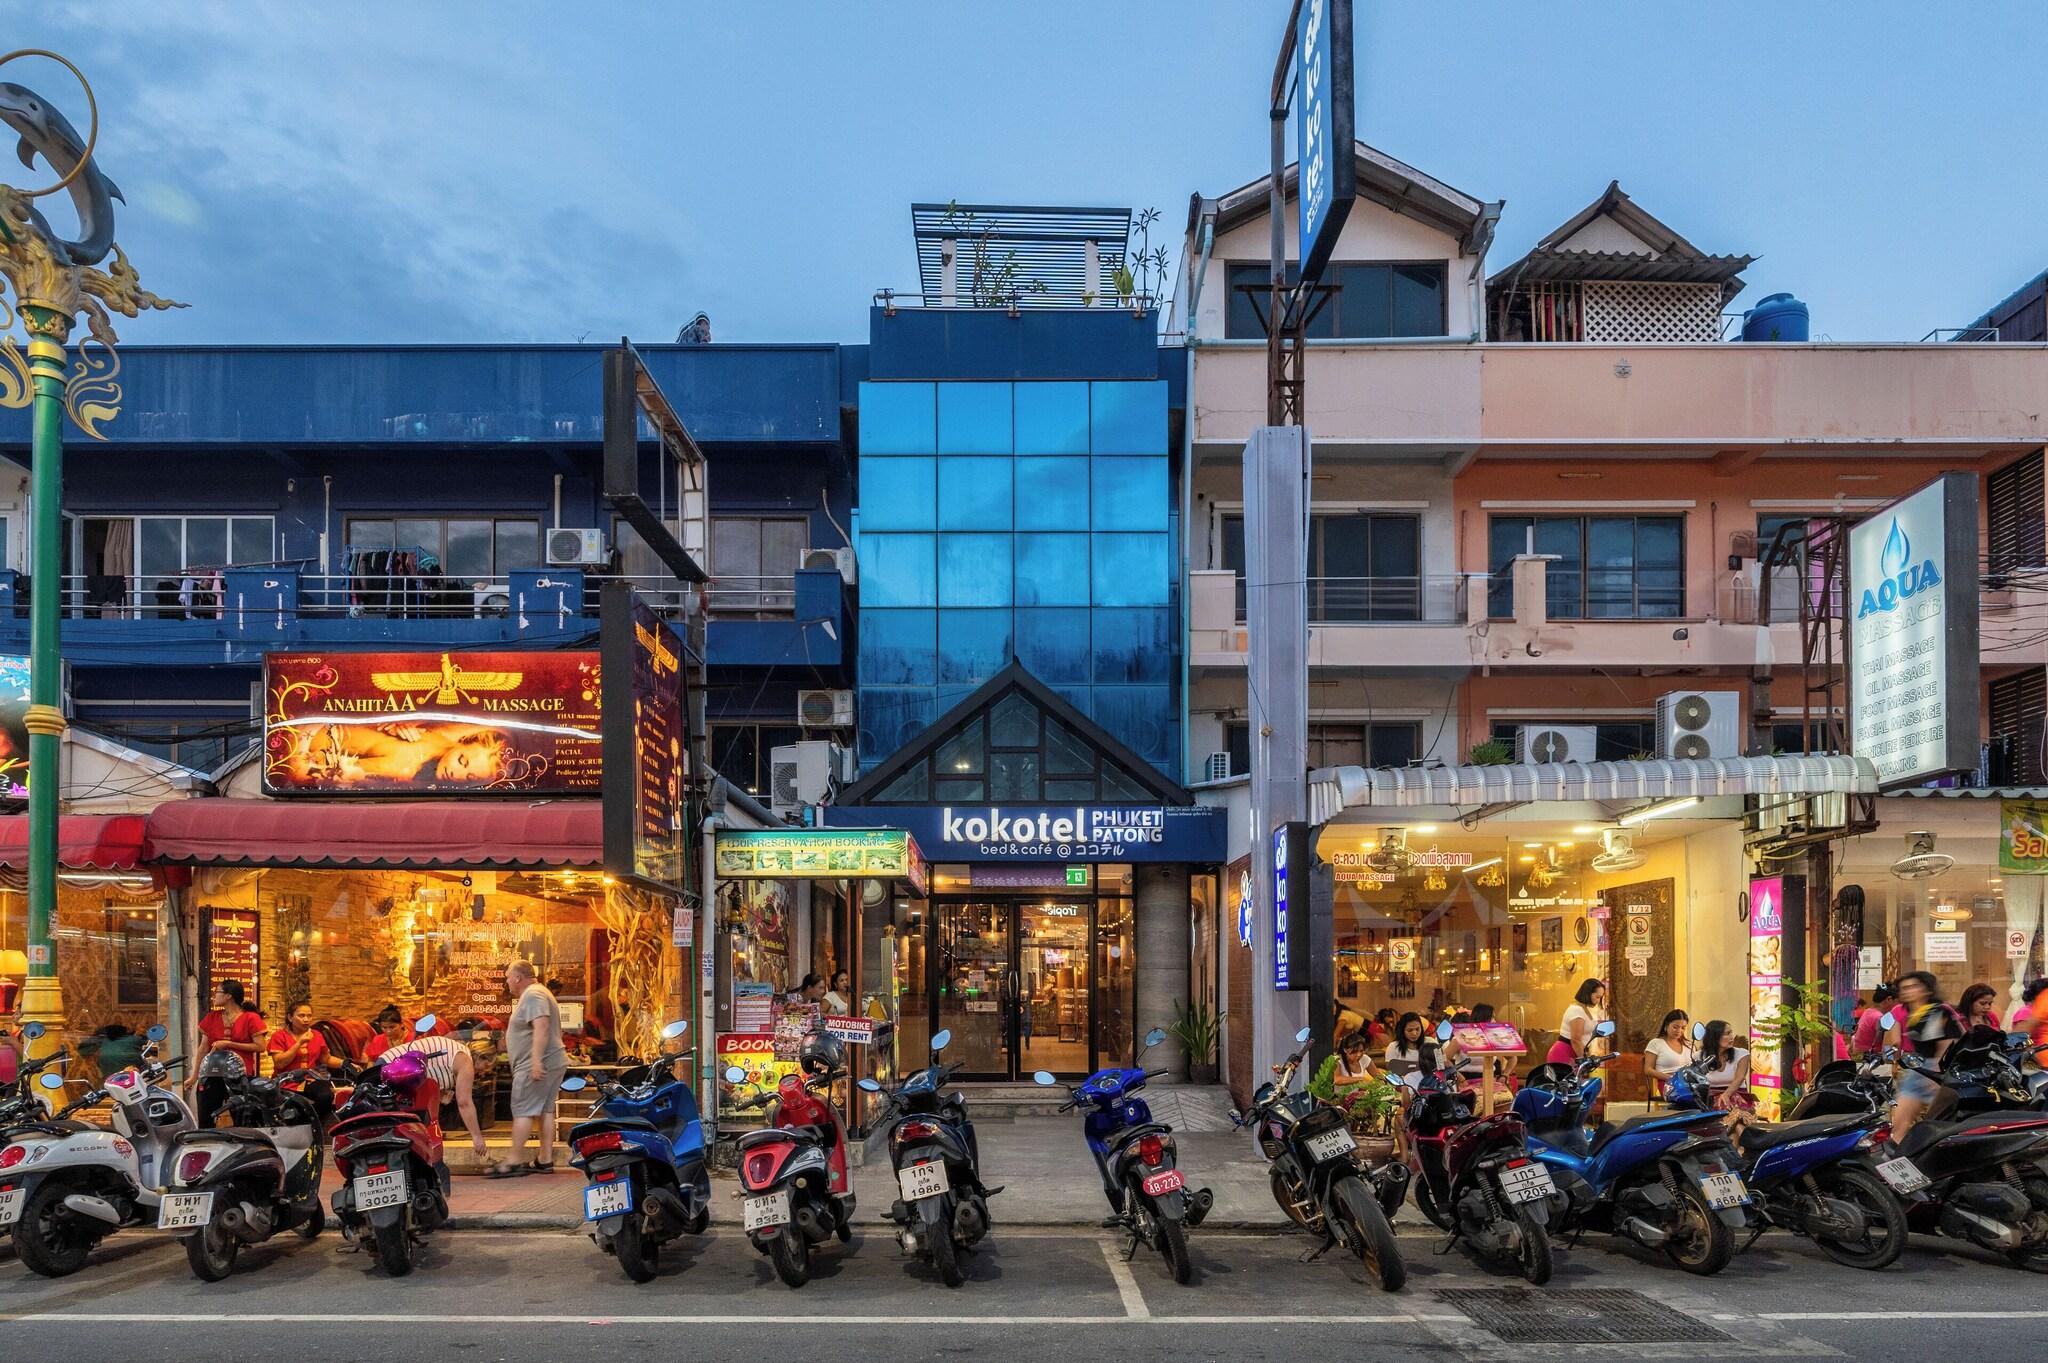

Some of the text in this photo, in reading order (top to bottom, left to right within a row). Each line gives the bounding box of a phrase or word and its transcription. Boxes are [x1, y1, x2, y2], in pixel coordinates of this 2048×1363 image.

[1857, 559, 1942, 620] AQUA
[1862, 636, 1936, 677] THAI MASSAGE
[1865, 660, 1932, 697] OIL MASSAGE
[324, 692, 564, 712] ANAHITAA MASSAGE
[1860, 681, 1938, 720] FOOT MASSAGE
[1856, 702, 1942, 743] FACIAL MASSAGE
[1899, 724, 1944, 750] PEDICURE
[1878, 755, 1918, 778] WAXING
[944, 808, 1088, 842] kokotel
[1092, 810, 1162, 826] PHUKET
[728, 837, 886, 848] TOUR RESERVATION BOOKING
[1092, 828, 1162, 843] PATONG
[1076, 844, 1125, 856] ココテル
[1335, 873, 1395, 882] AQUA MASSAGE
[1754, 914, 1782, 930] AQUA
[458, 968, 506, 978] Welcom
[466, 982, 504, 990] No Sex
[472, 994, 496, 1003] Open
[828, 1018, 870, 1031] MOTOBIKE
[847, 1033, 869, 1041] RENT
[1322, 1144, 1351, 1160] 8969
[912, 1184, 940, 1197] 1986
[1518, 1185, 1548, 1200] 1205
[366, 1194, 398, 1207] 3002
[1716, 1194, 1744, 1206] 8684
[594, 1202, 624, 1216] 7510
[171, 1214, 197, 1225] 618
